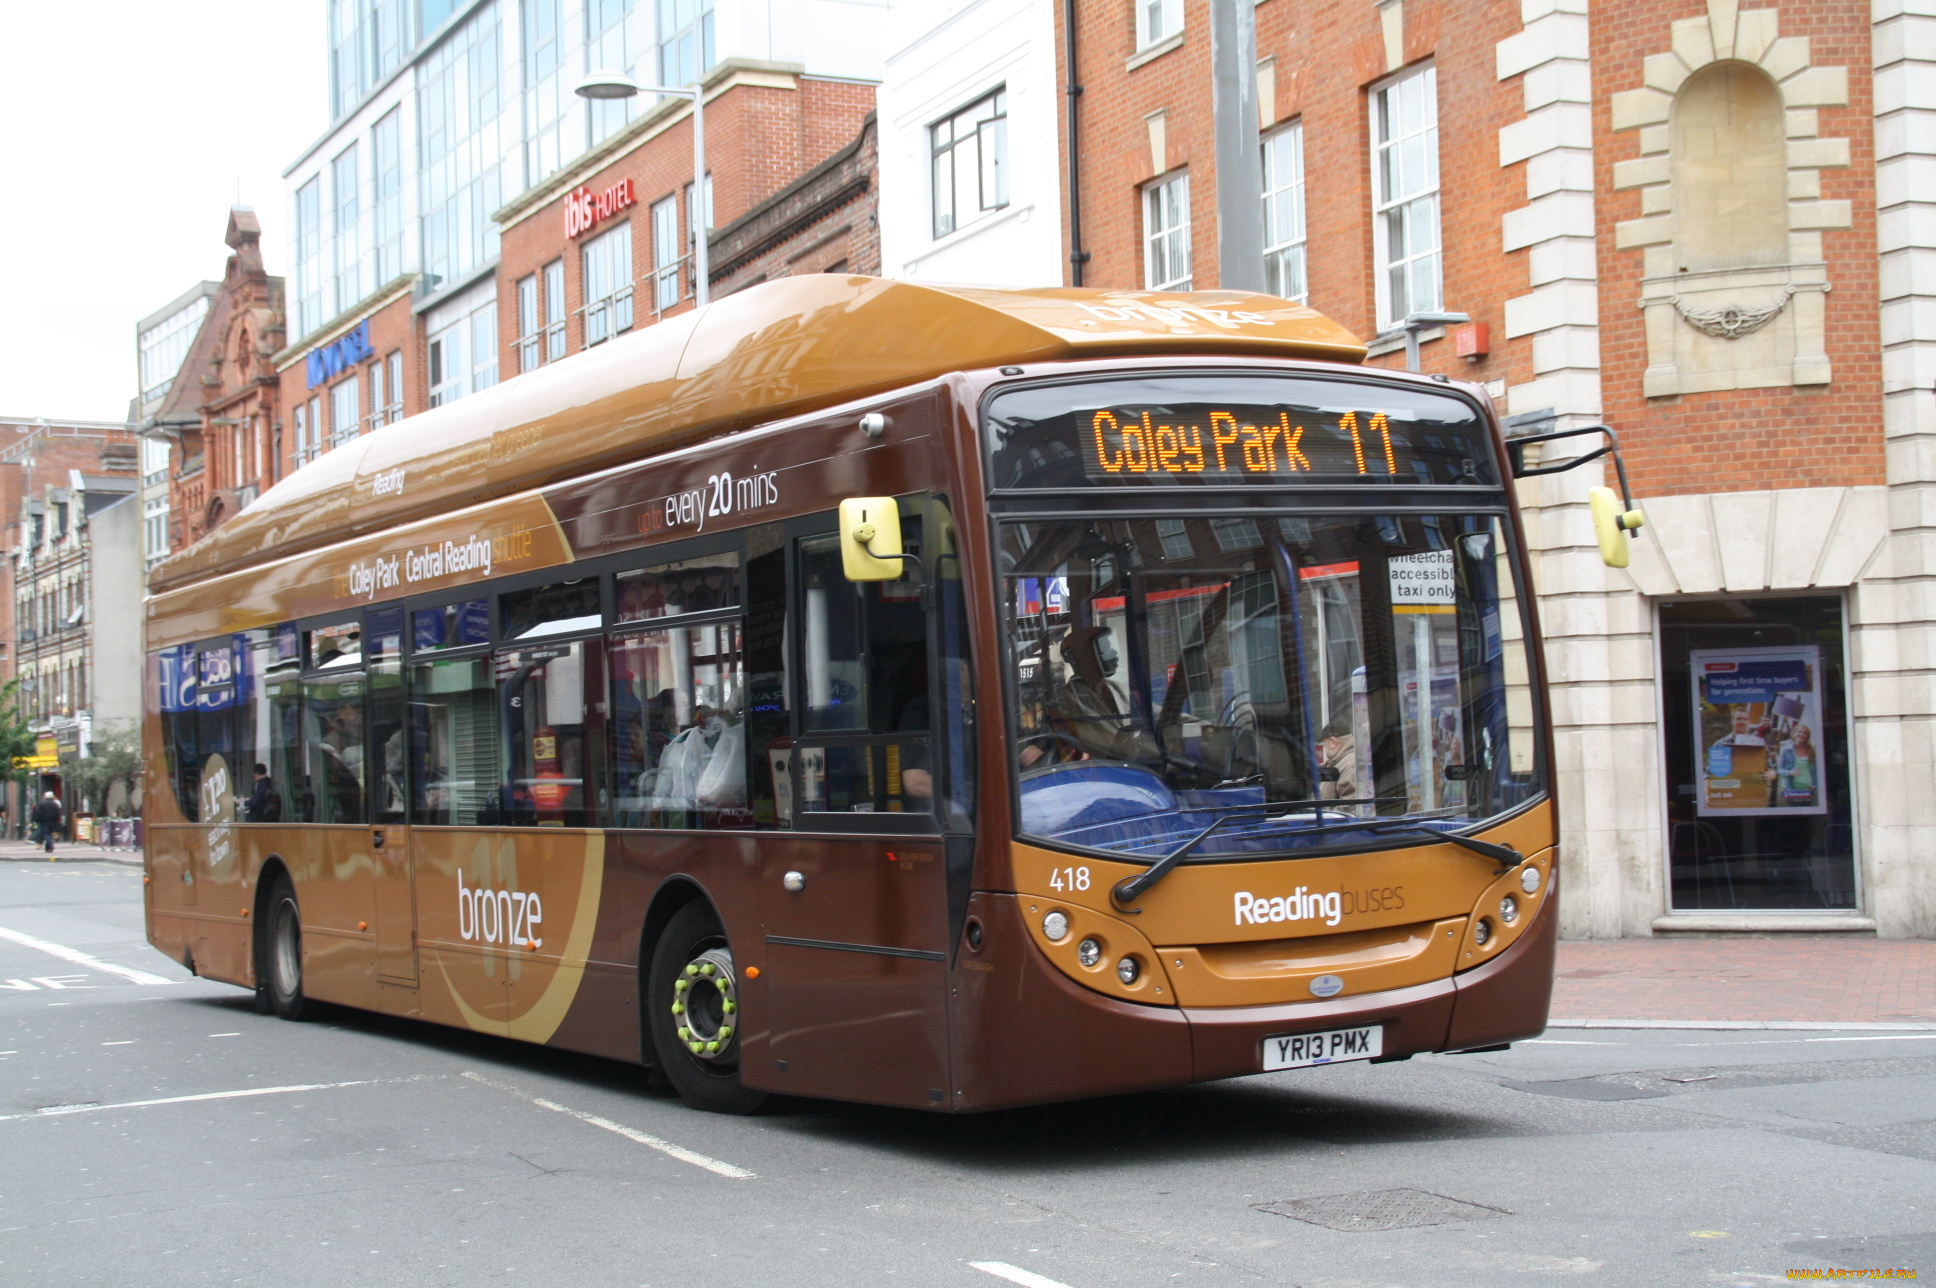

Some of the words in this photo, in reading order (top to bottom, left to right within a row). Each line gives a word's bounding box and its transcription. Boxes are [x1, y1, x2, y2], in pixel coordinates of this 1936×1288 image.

[564, 185, 594, 240] ibis
[595, 178, 633, 223] HOTEL
[1073, 302, 1276, 325] bronze
[1092, 410, 1206, 473] Coley
[1209, 411, 1311, 473] Park
[1338, 410, 1397, 474] 11
[372, 467, 406, 496] Reading
[637, 512, 650, 539] up
[651, 504, 663, 530] to
[665, 488, 707, 533] every
[708, 471, 733, 518] 20
[737, 464, 778, 512] mins
[349, 562, 376, 600] Coley
[377, 554, 400, 590] Park
[405, 543, 443, 583] Central
[445, 534, 491, 576] Reading
[493, 522, 532, 564] shuttle
[1397, 584, 1423, 597] taxi
[1428, 584, 1456, 599] only
[1020, 667, 1034, 679] 1515
[1710, 678, 1738, 686] Helping
[1738, 676, 1755, 684] first
[1755, 676, 1772, 684] time
[1773, 676, 1799, 685] buyers
[1723, 687, 1766, 696] generations
[1049, 866, 1091, 892] 418
[458, 867, 543, 948] bronze
[1278, 1035, 1323, 1062] YR13
[1330, 1029, 1370, 1057] PMX
